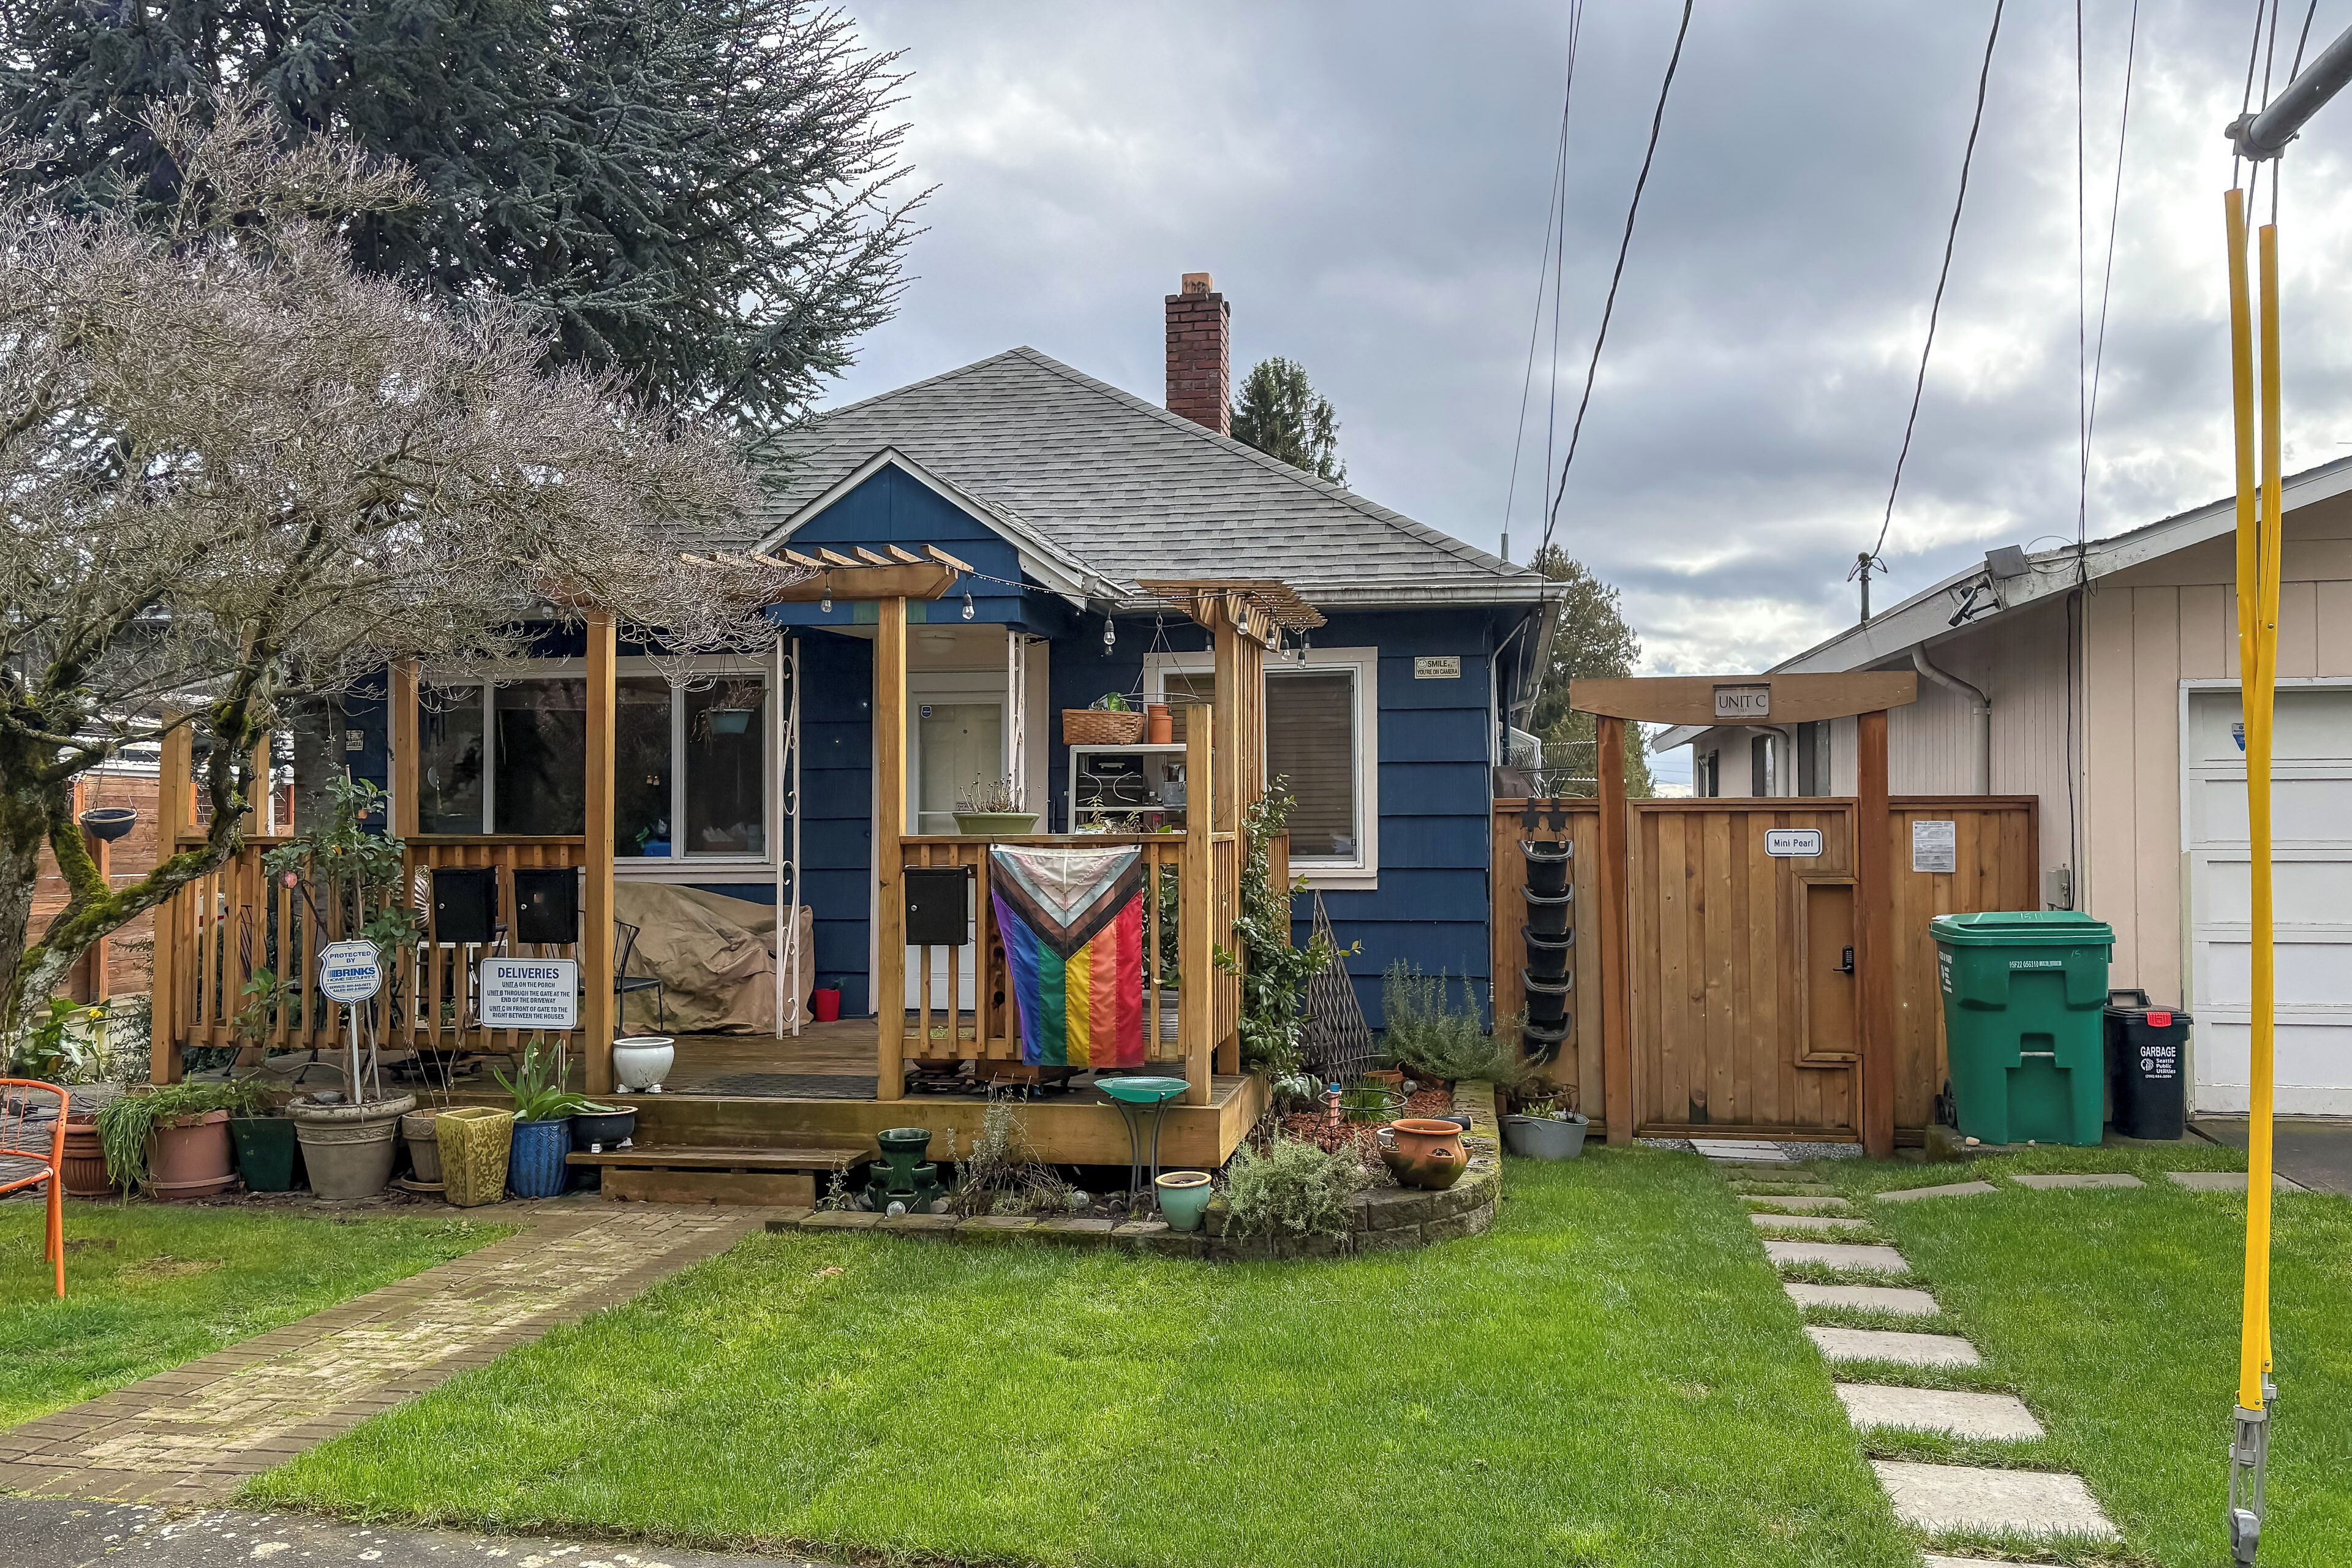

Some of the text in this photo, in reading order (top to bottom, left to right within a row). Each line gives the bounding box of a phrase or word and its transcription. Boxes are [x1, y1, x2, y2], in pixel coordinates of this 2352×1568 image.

[1719, 695, 1766, 708] UNIT C
[1793, 839, 1813, 847] Pearl
[335, 967, 375, 977] BRINKS
[498, 967, 559, 979] DELIVERIES
[2140, 1046, 2176, 1057] GARBAGE
